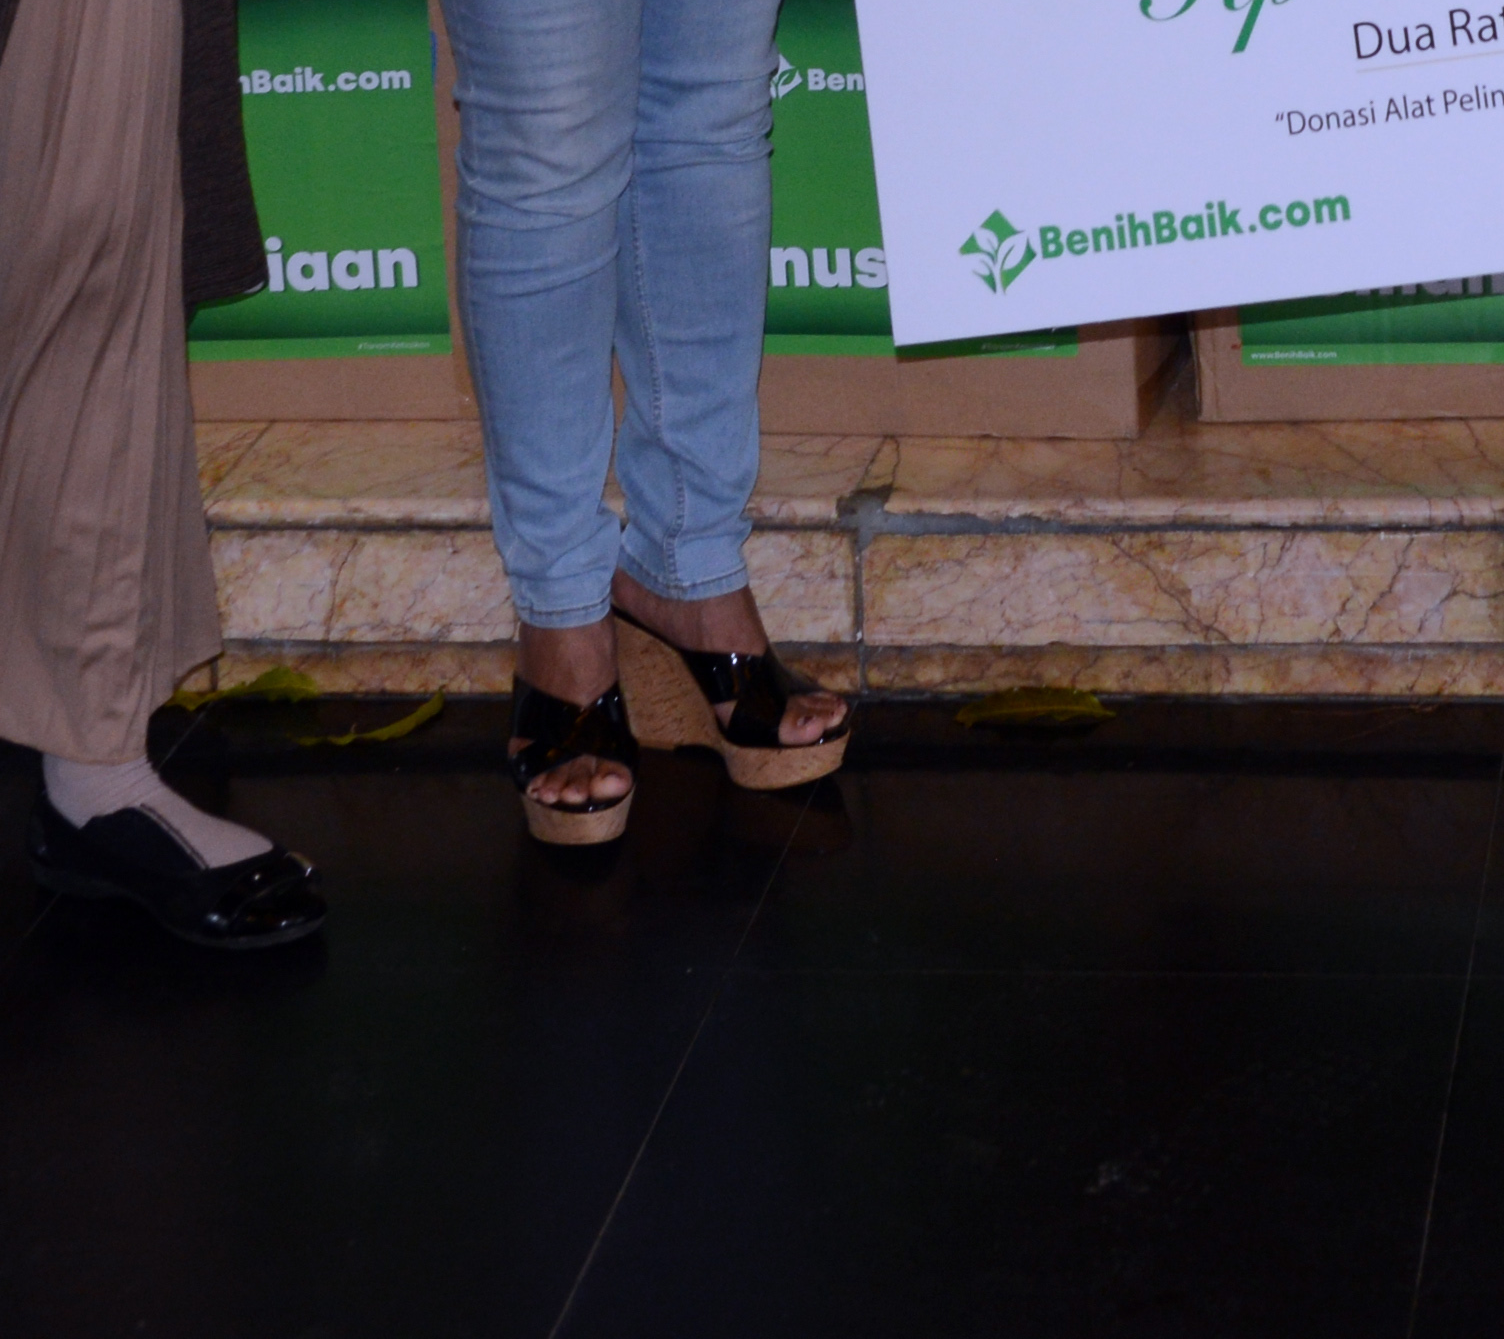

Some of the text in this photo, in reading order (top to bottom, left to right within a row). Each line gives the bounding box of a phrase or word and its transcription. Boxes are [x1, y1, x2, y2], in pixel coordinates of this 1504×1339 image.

[1353, 22, 1435, 59] Dua
[1275, 107, 1376, 135] “Donasi
[1385, 95, 1435, 122] Alat
[1039, 196, 1350, 259] BenihBaik.com
